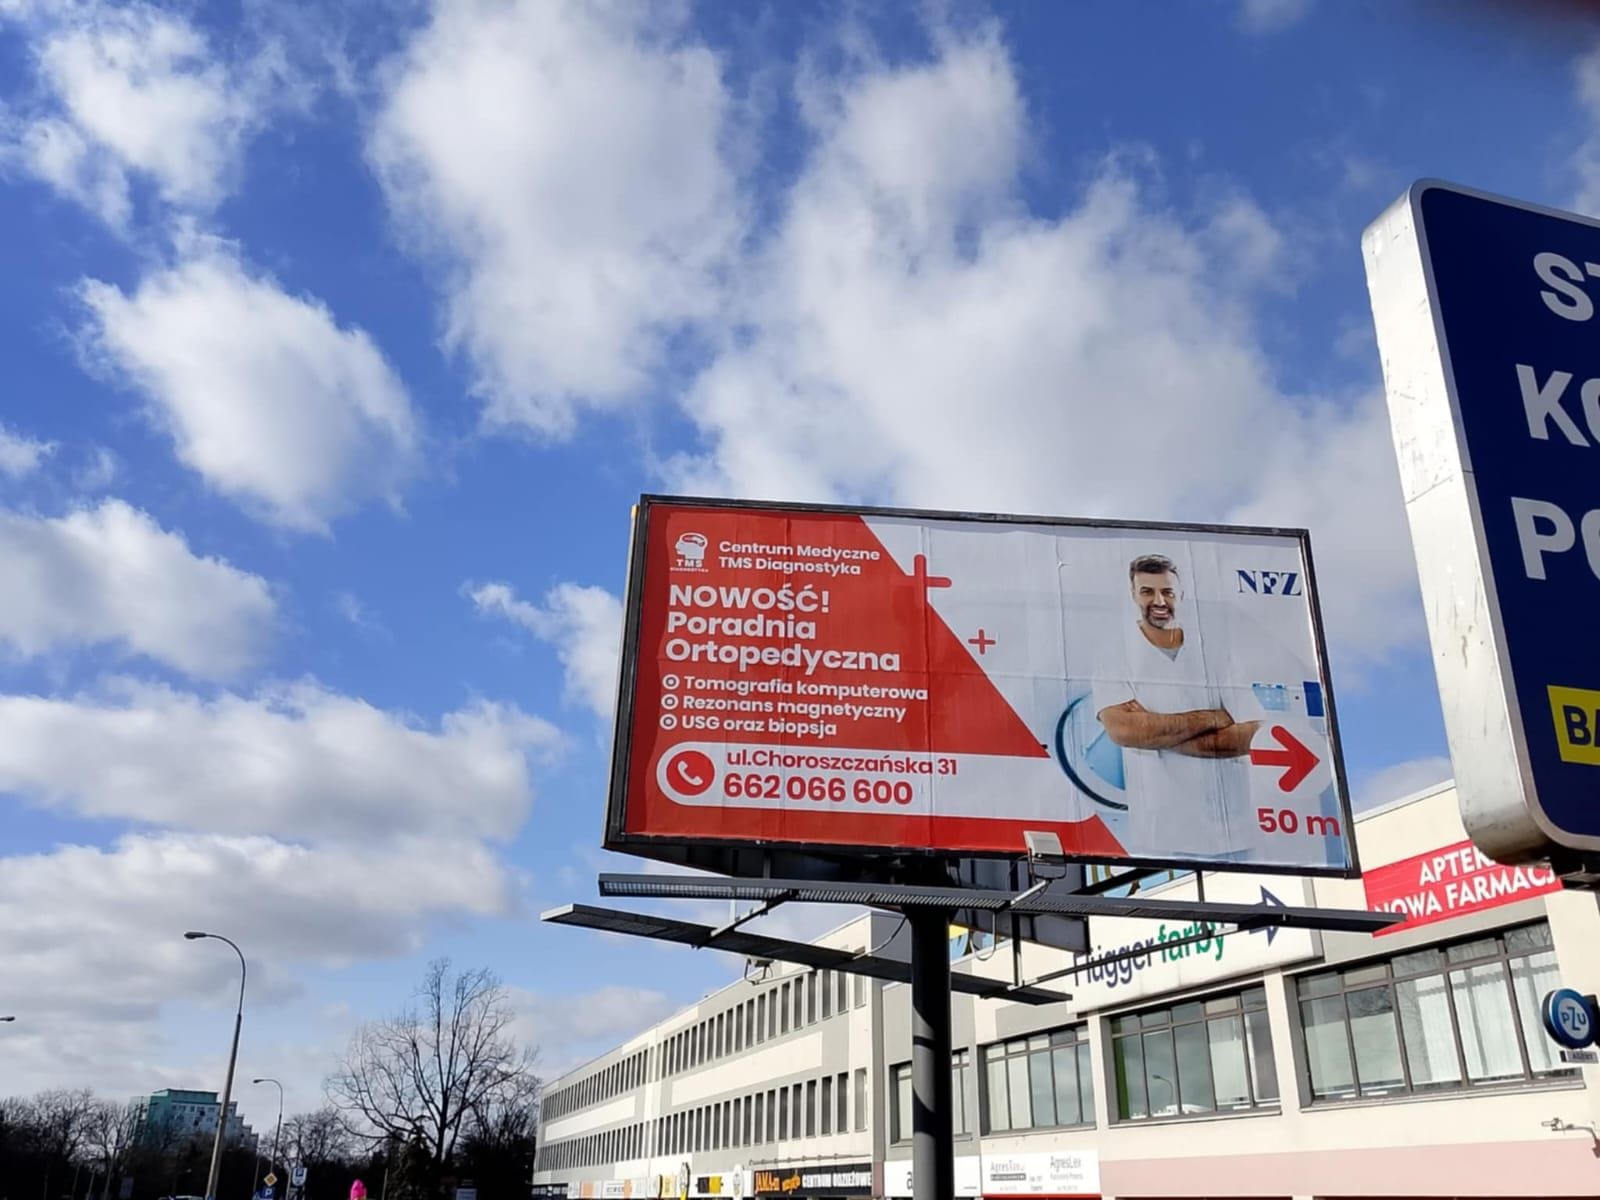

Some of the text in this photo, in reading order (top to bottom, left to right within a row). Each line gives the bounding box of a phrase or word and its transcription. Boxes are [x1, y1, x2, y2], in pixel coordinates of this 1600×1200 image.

[1533, 252, 1600, 321] S
[675, 559, 703, 568] TMS
[719, 541, 880, 562] Centrum Medyczne
[719, 556, 861, 577] TMS Diagnostyka
[1236, 570, 1302, 596] NFZ
[669, 583, 830, 613] NOWOŚĆ!
[668, 611, 816, 640] Poradnia
[665, 638, 900, 674] Ortopedyczna
[684, 675, 928, 701] Tomografia komputerowa
[683, 696, 906, 722] Rezonans magnetyczny
[681, 715, 837, 738] USG oraz biopsja
[1562, 704, 1600, 748] B
[727, 750, 957, 775] ul.Choroszczańska 31
[723, 773, 913, 805] 662 066 600
[1257, 808, 1341, 837] 50 m
[1419, 846, 1496, 886] APTEK
[1158, 921, 1225, 963] farby
[1561, 1006, 1587, 1031] PZU
